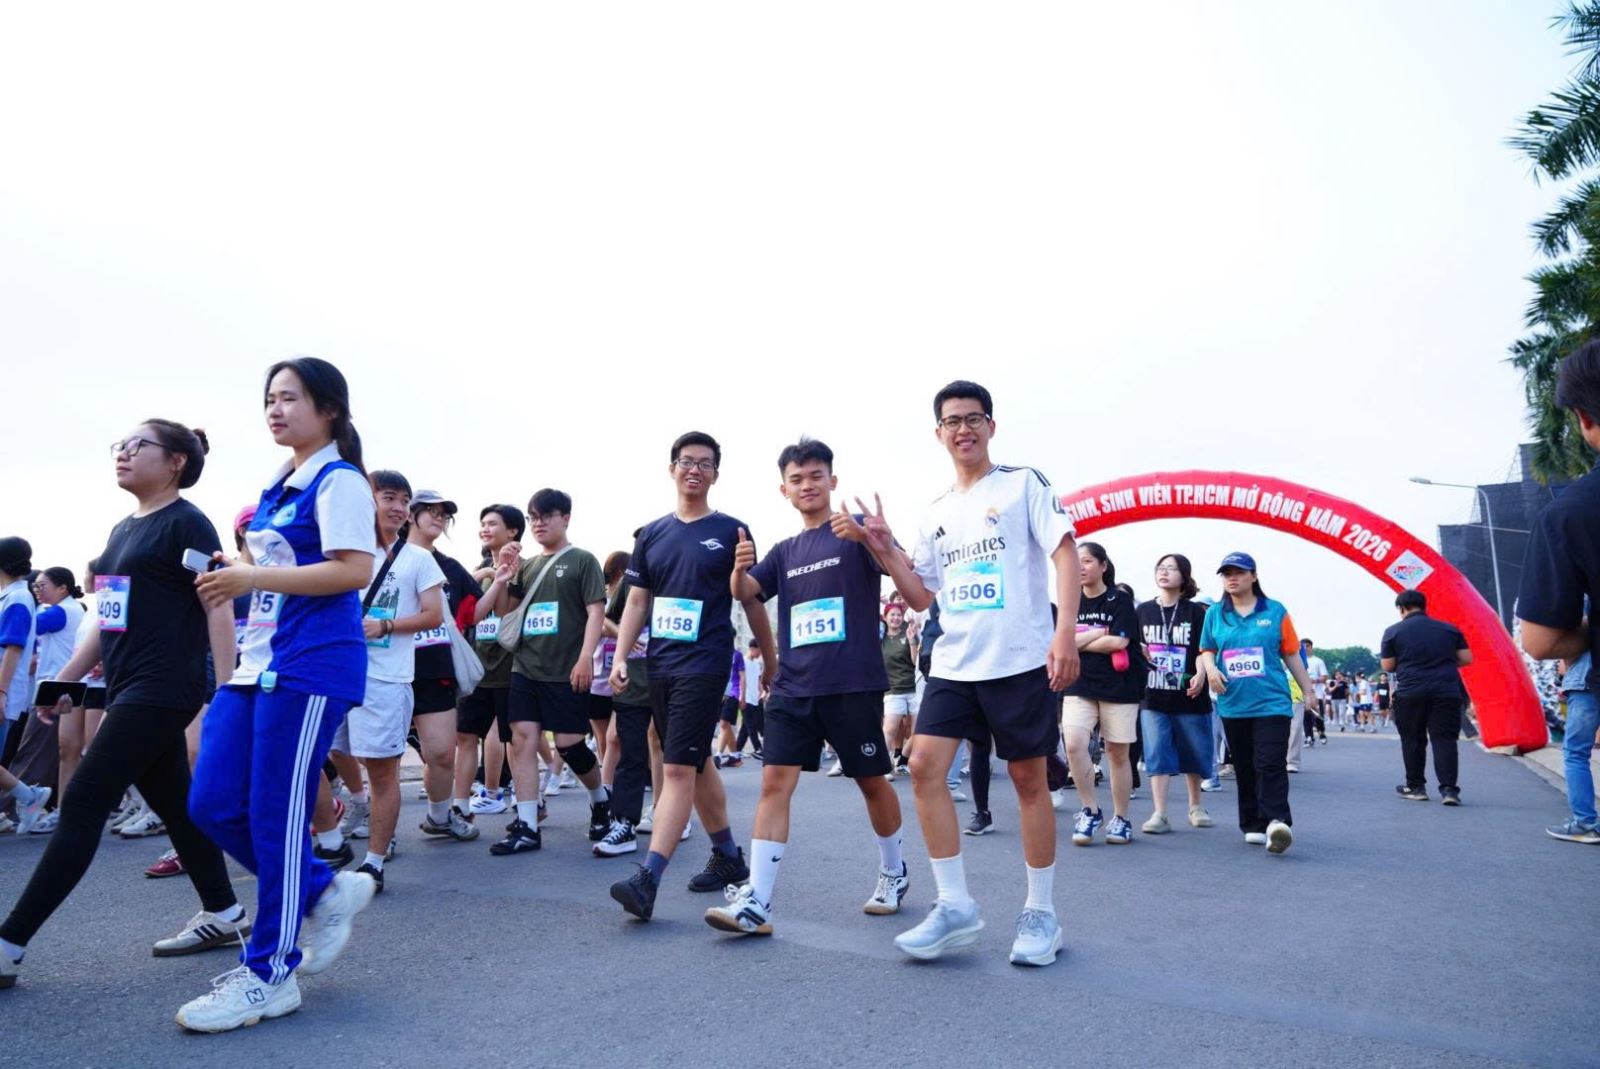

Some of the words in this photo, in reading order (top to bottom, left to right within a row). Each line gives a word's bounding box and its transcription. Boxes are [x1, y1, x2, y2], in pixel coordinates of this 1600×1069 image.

[1100, 488, 1137, 514] SINH
[1138, 482, 1173, 507] VIÊN
[1174, 484, 1230, 506] TP.HCM
[1231, 484, 1260, 509] MỞ
[1258, 490, 1306, 524] RỘNG
[1305, 505, 1348, 538] NĂM
[1342, 523, 1392, 562] 2026
[786, 556, 841, 579] SKECHERS
[950, 582, 996, 603] 1506
[527, 616, 553, 629] 1615
[656, 616, 693, 632] 1158
[1076, 612, 1114, 622] UMMER
[795, 617, 836, 637] 1151
[1172, 625, 1192, 646] ME
[1151, 656, 1181, 668] 473
[1228, 660, 1260, 672] 4960
[245, 988, 265, 1005] N
